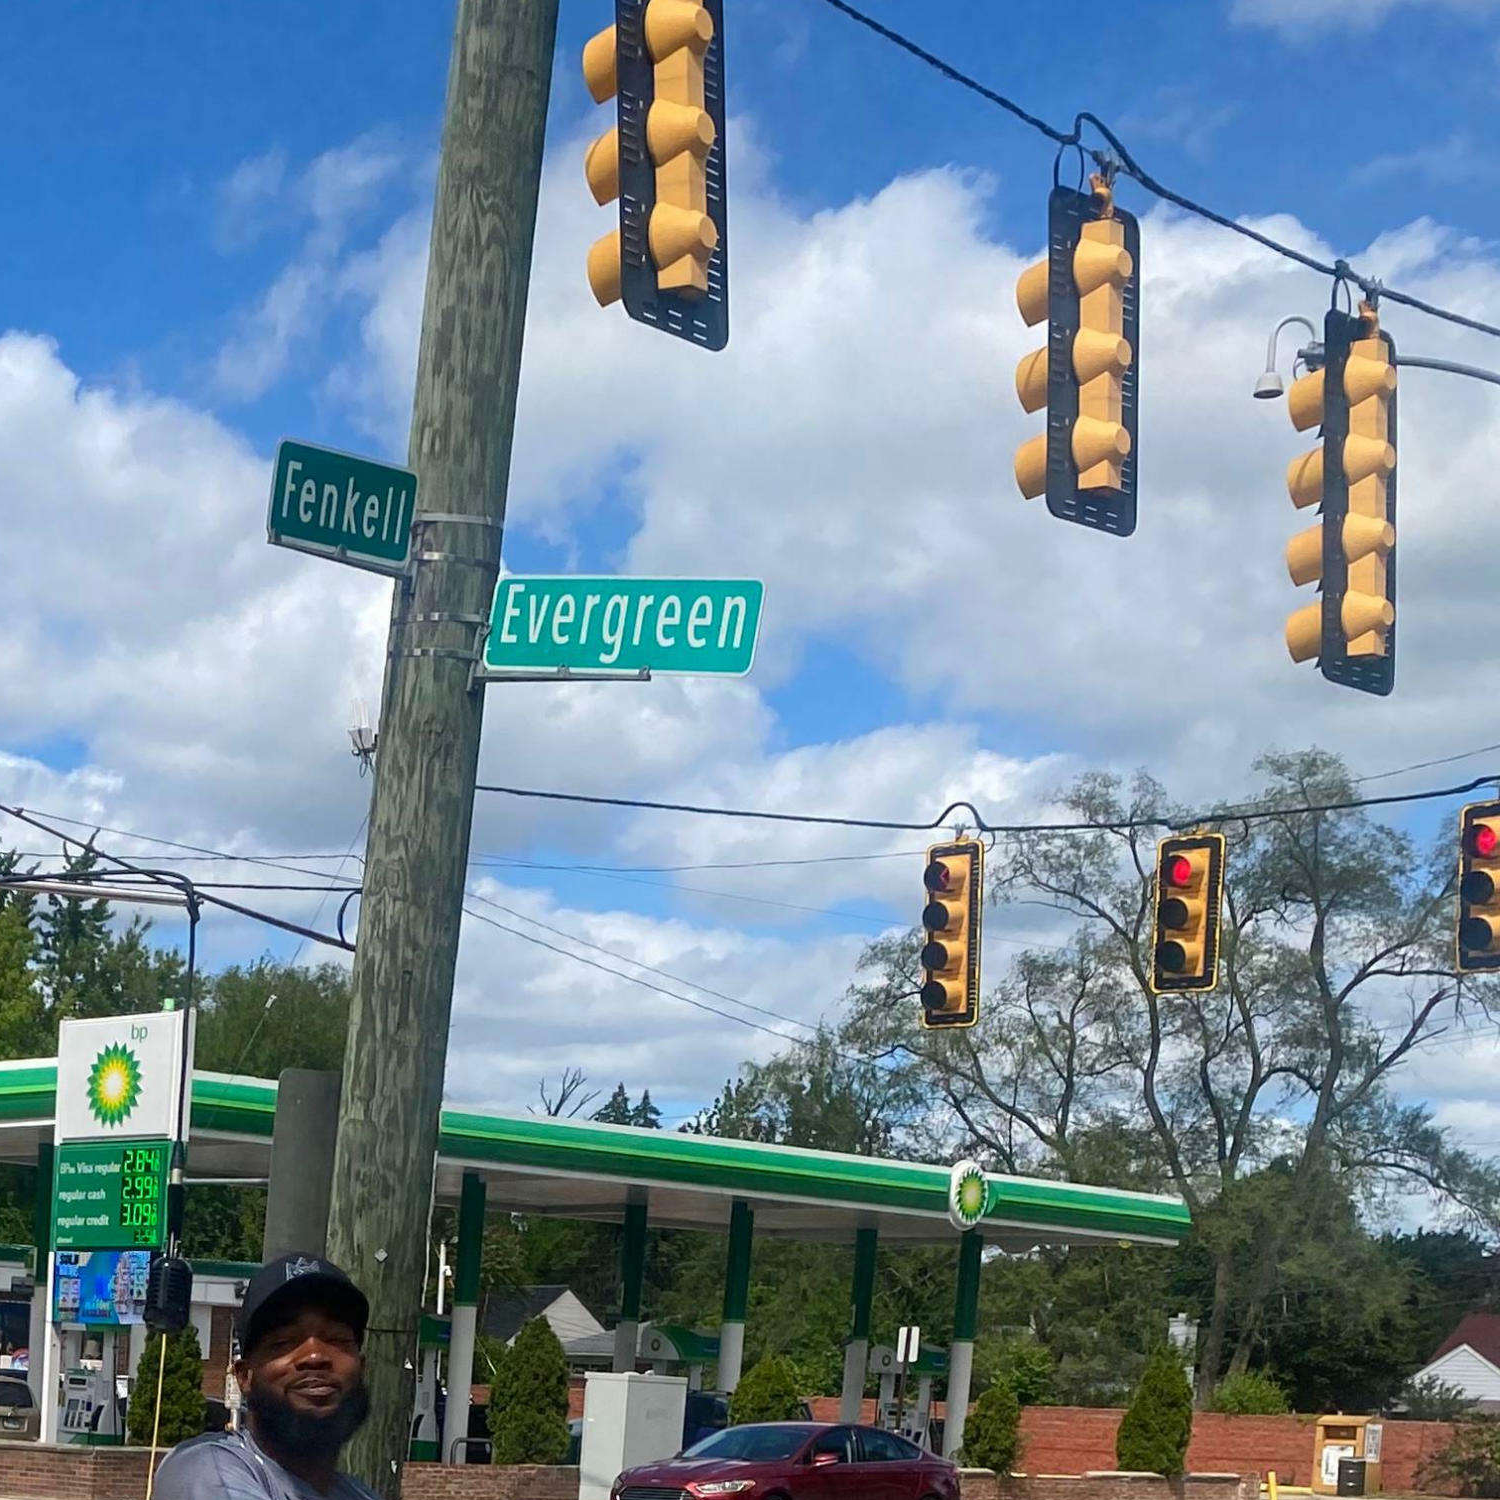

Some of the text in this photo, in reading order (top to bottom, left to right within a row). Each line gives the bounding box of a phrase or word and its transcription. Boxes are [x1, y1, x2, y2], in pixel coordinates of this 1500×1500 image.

[281, 461, 407, 545] Fenkell
[501, 584, 748, 664] Evergreen
[131, 1023, 148, 1043] bp
[94, 1162, 121, 1176] regular
[58, 1189, 86, 1203] regular
[87, 1188, 106, 1200] cash
[57, 1215, 85, 1228] regular
[86, 1214, 109, 1226] credit
